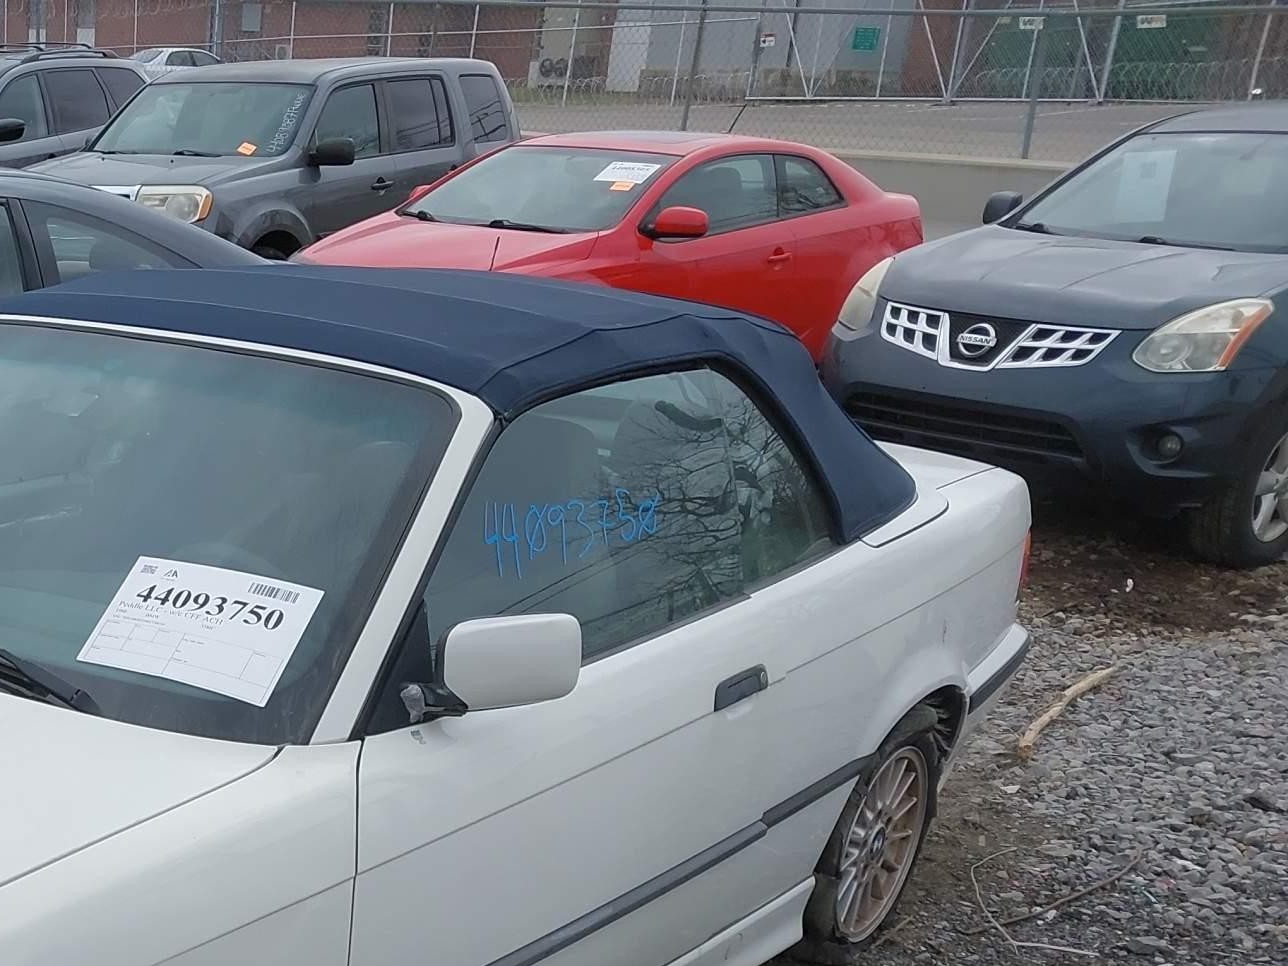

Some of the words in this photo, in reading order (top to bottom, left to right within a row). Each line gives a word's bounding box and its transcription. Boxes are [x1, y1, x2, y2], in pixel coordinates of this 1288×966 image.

[960, 335, 992, 345] NISSAN
[483, 487, 661, 580] 44093750
[137, 584, 284, 630] 44093750
